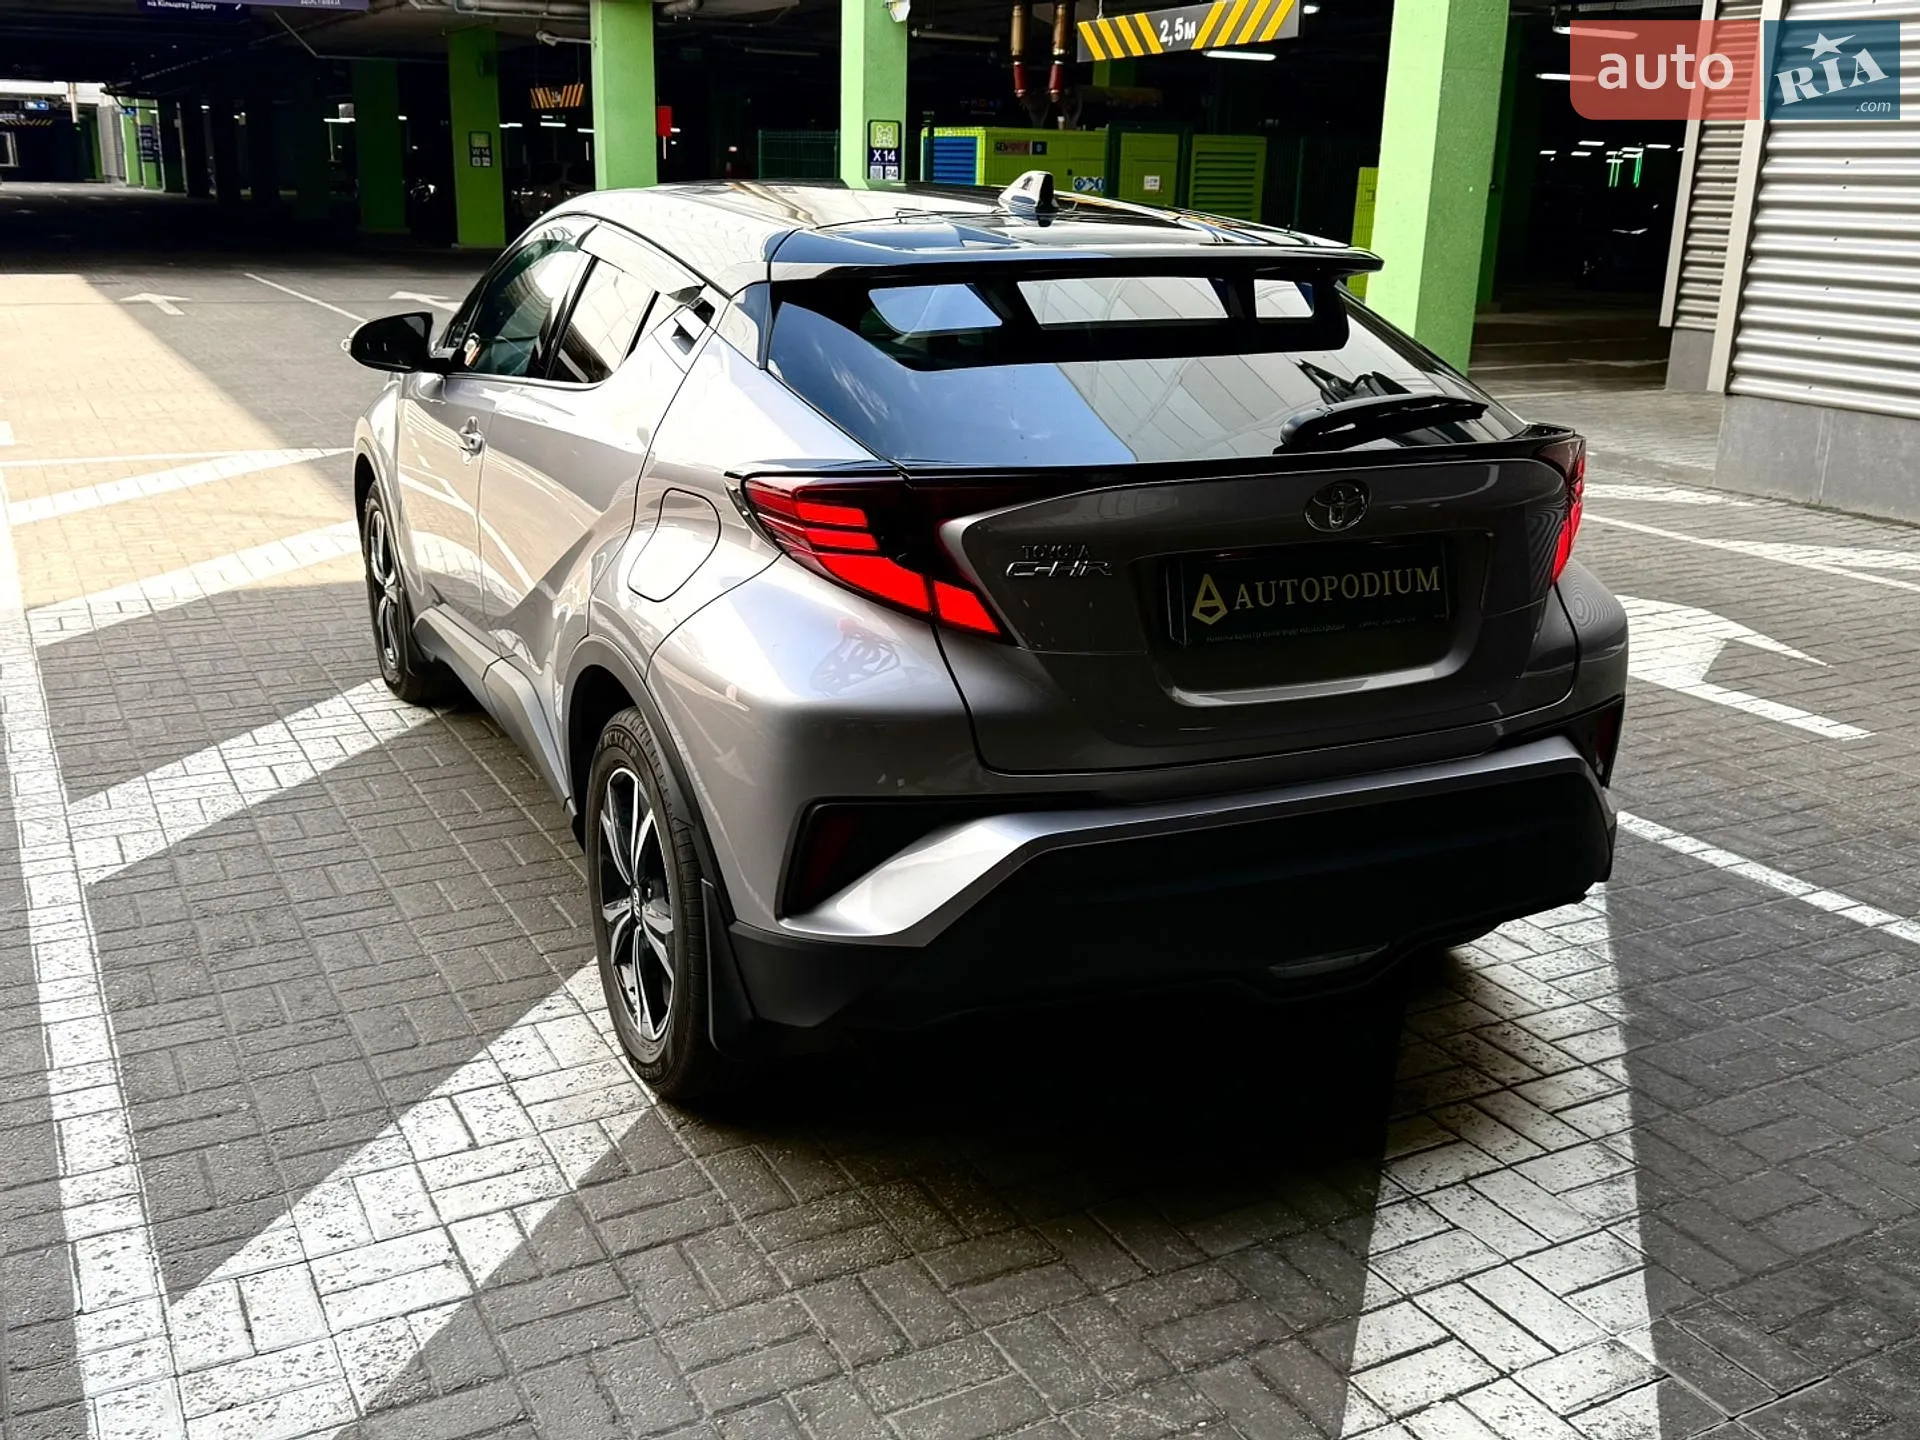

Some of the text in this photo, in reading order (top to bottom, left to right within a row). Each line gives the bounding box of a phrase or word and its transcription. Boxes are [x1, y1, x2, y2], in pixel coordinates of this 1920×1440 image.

[1020, 544, 1090, 560] TOYOTA
[1006, 560, 1113, 577] C-HR
[1234, 566, 1441, 611] AUTOPODIUM
